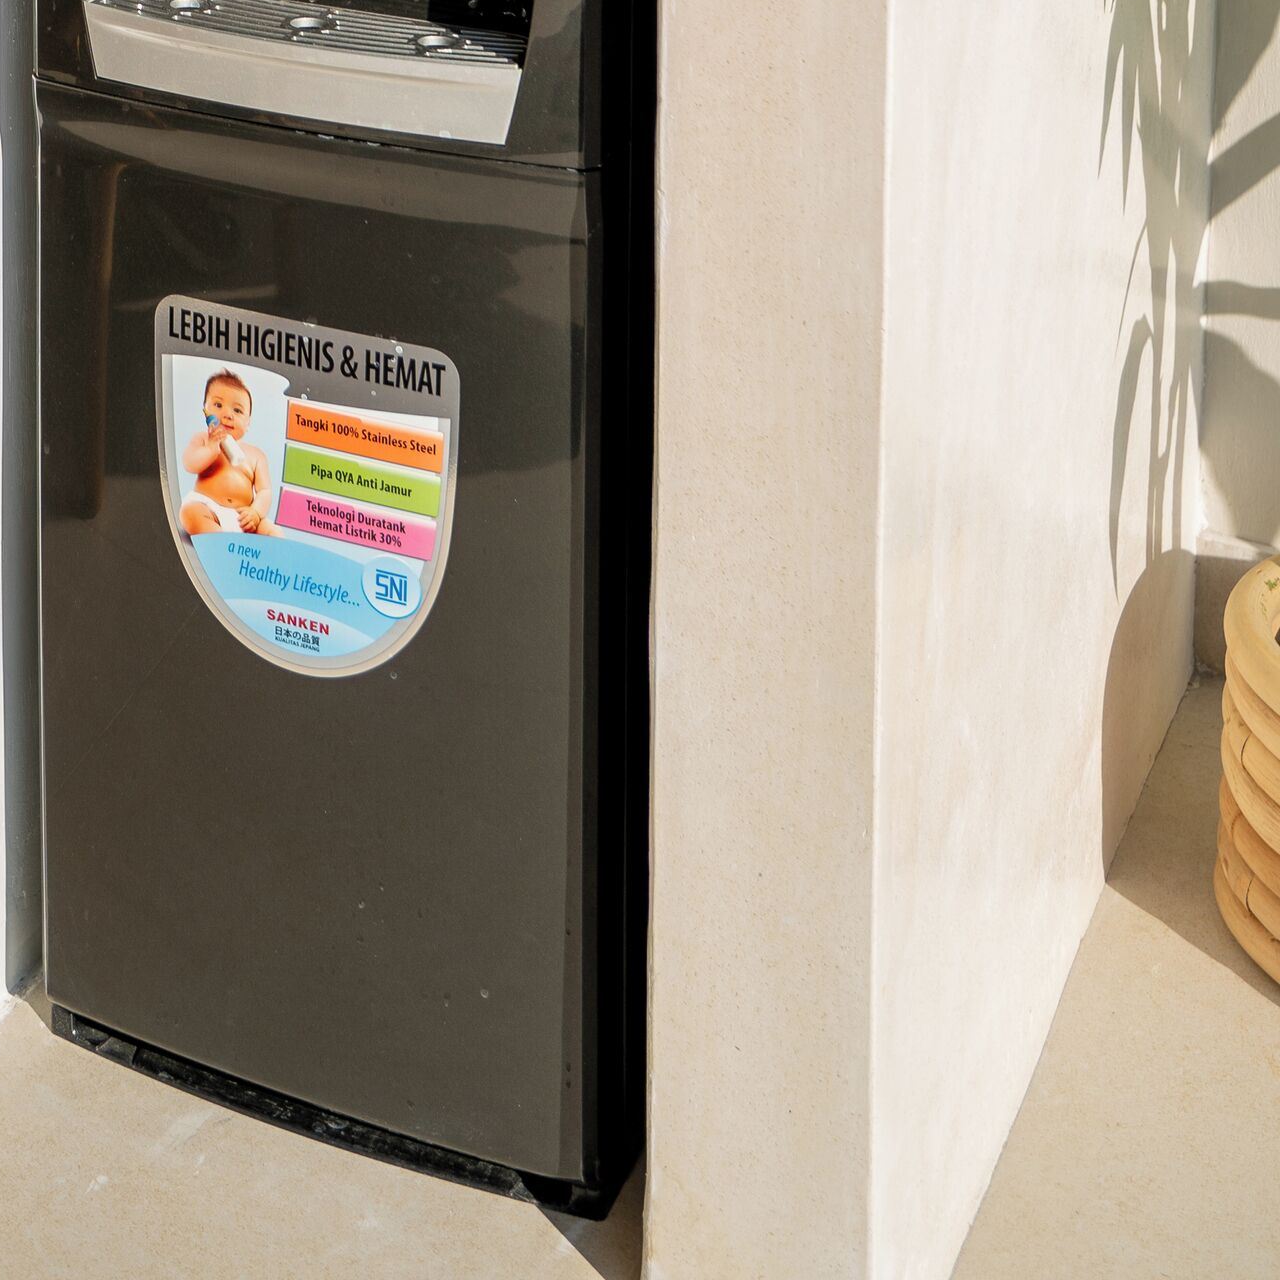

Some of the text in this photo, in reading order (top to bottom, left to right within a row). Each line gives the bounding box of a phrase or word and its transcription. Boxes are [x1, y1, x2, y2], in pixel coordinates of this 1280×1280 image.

[169, 305, 446, 397] LEBIH HIGIENIS & HEMAT
[295, 413, 437, 456] Tangki 100% Stainless Steel
[310, 463, 412, 498] Pipa QYA Anti Jamur
[306, 499, 406, 534] Teknologi Duratank
[309, 515, 402, 548] Hemat Listrik 30%
[228, 542, 261, 560] a new
[238, 559, 291, 591] Healthy
[375, 571, 408, 604] SNI
[266, 608, 330, 636] SANKEN
[274, 626, 320, 646] 日本の品質
[274, 636, 320, 653] KUALITAS JEPANG
